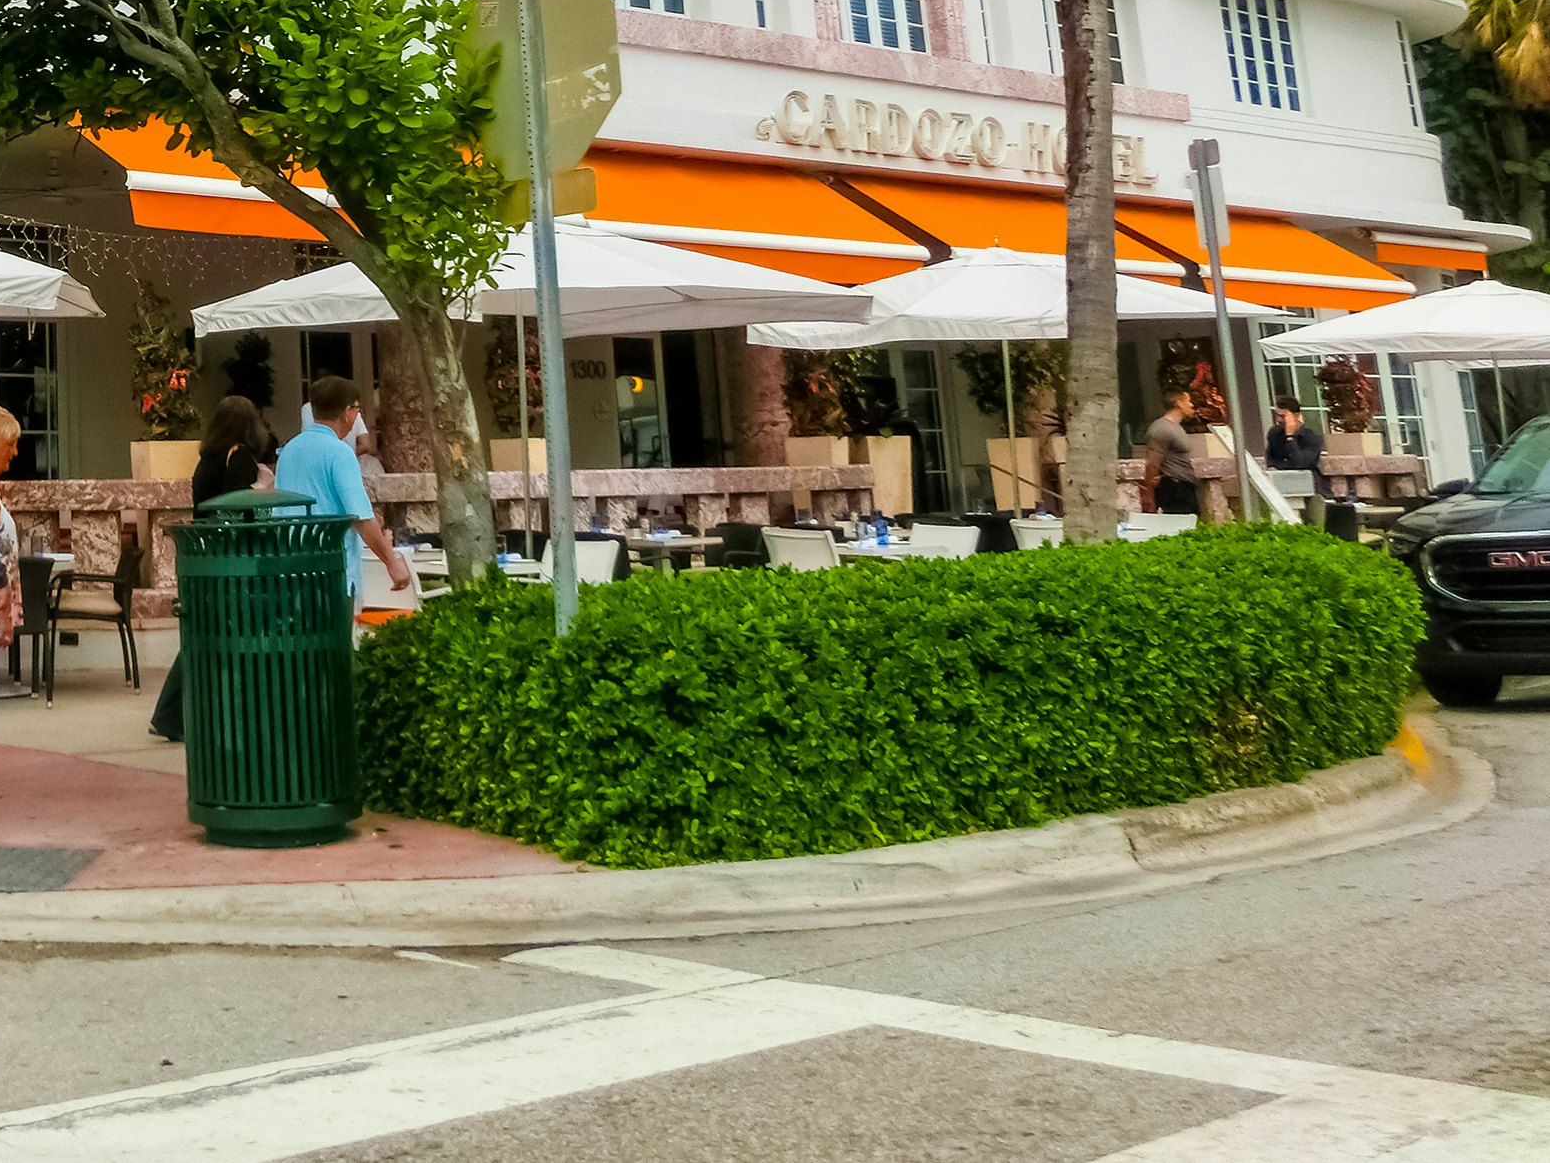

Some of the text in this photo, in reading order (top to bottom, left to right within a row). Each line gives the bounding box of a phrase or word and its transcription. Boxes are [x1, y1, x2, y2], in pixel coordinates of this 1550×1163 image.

[776, 90, 1007, 167] CARDOZO
[569, 358, 607, 380] 1300
[1488, 550, 1550, 567] GMC
